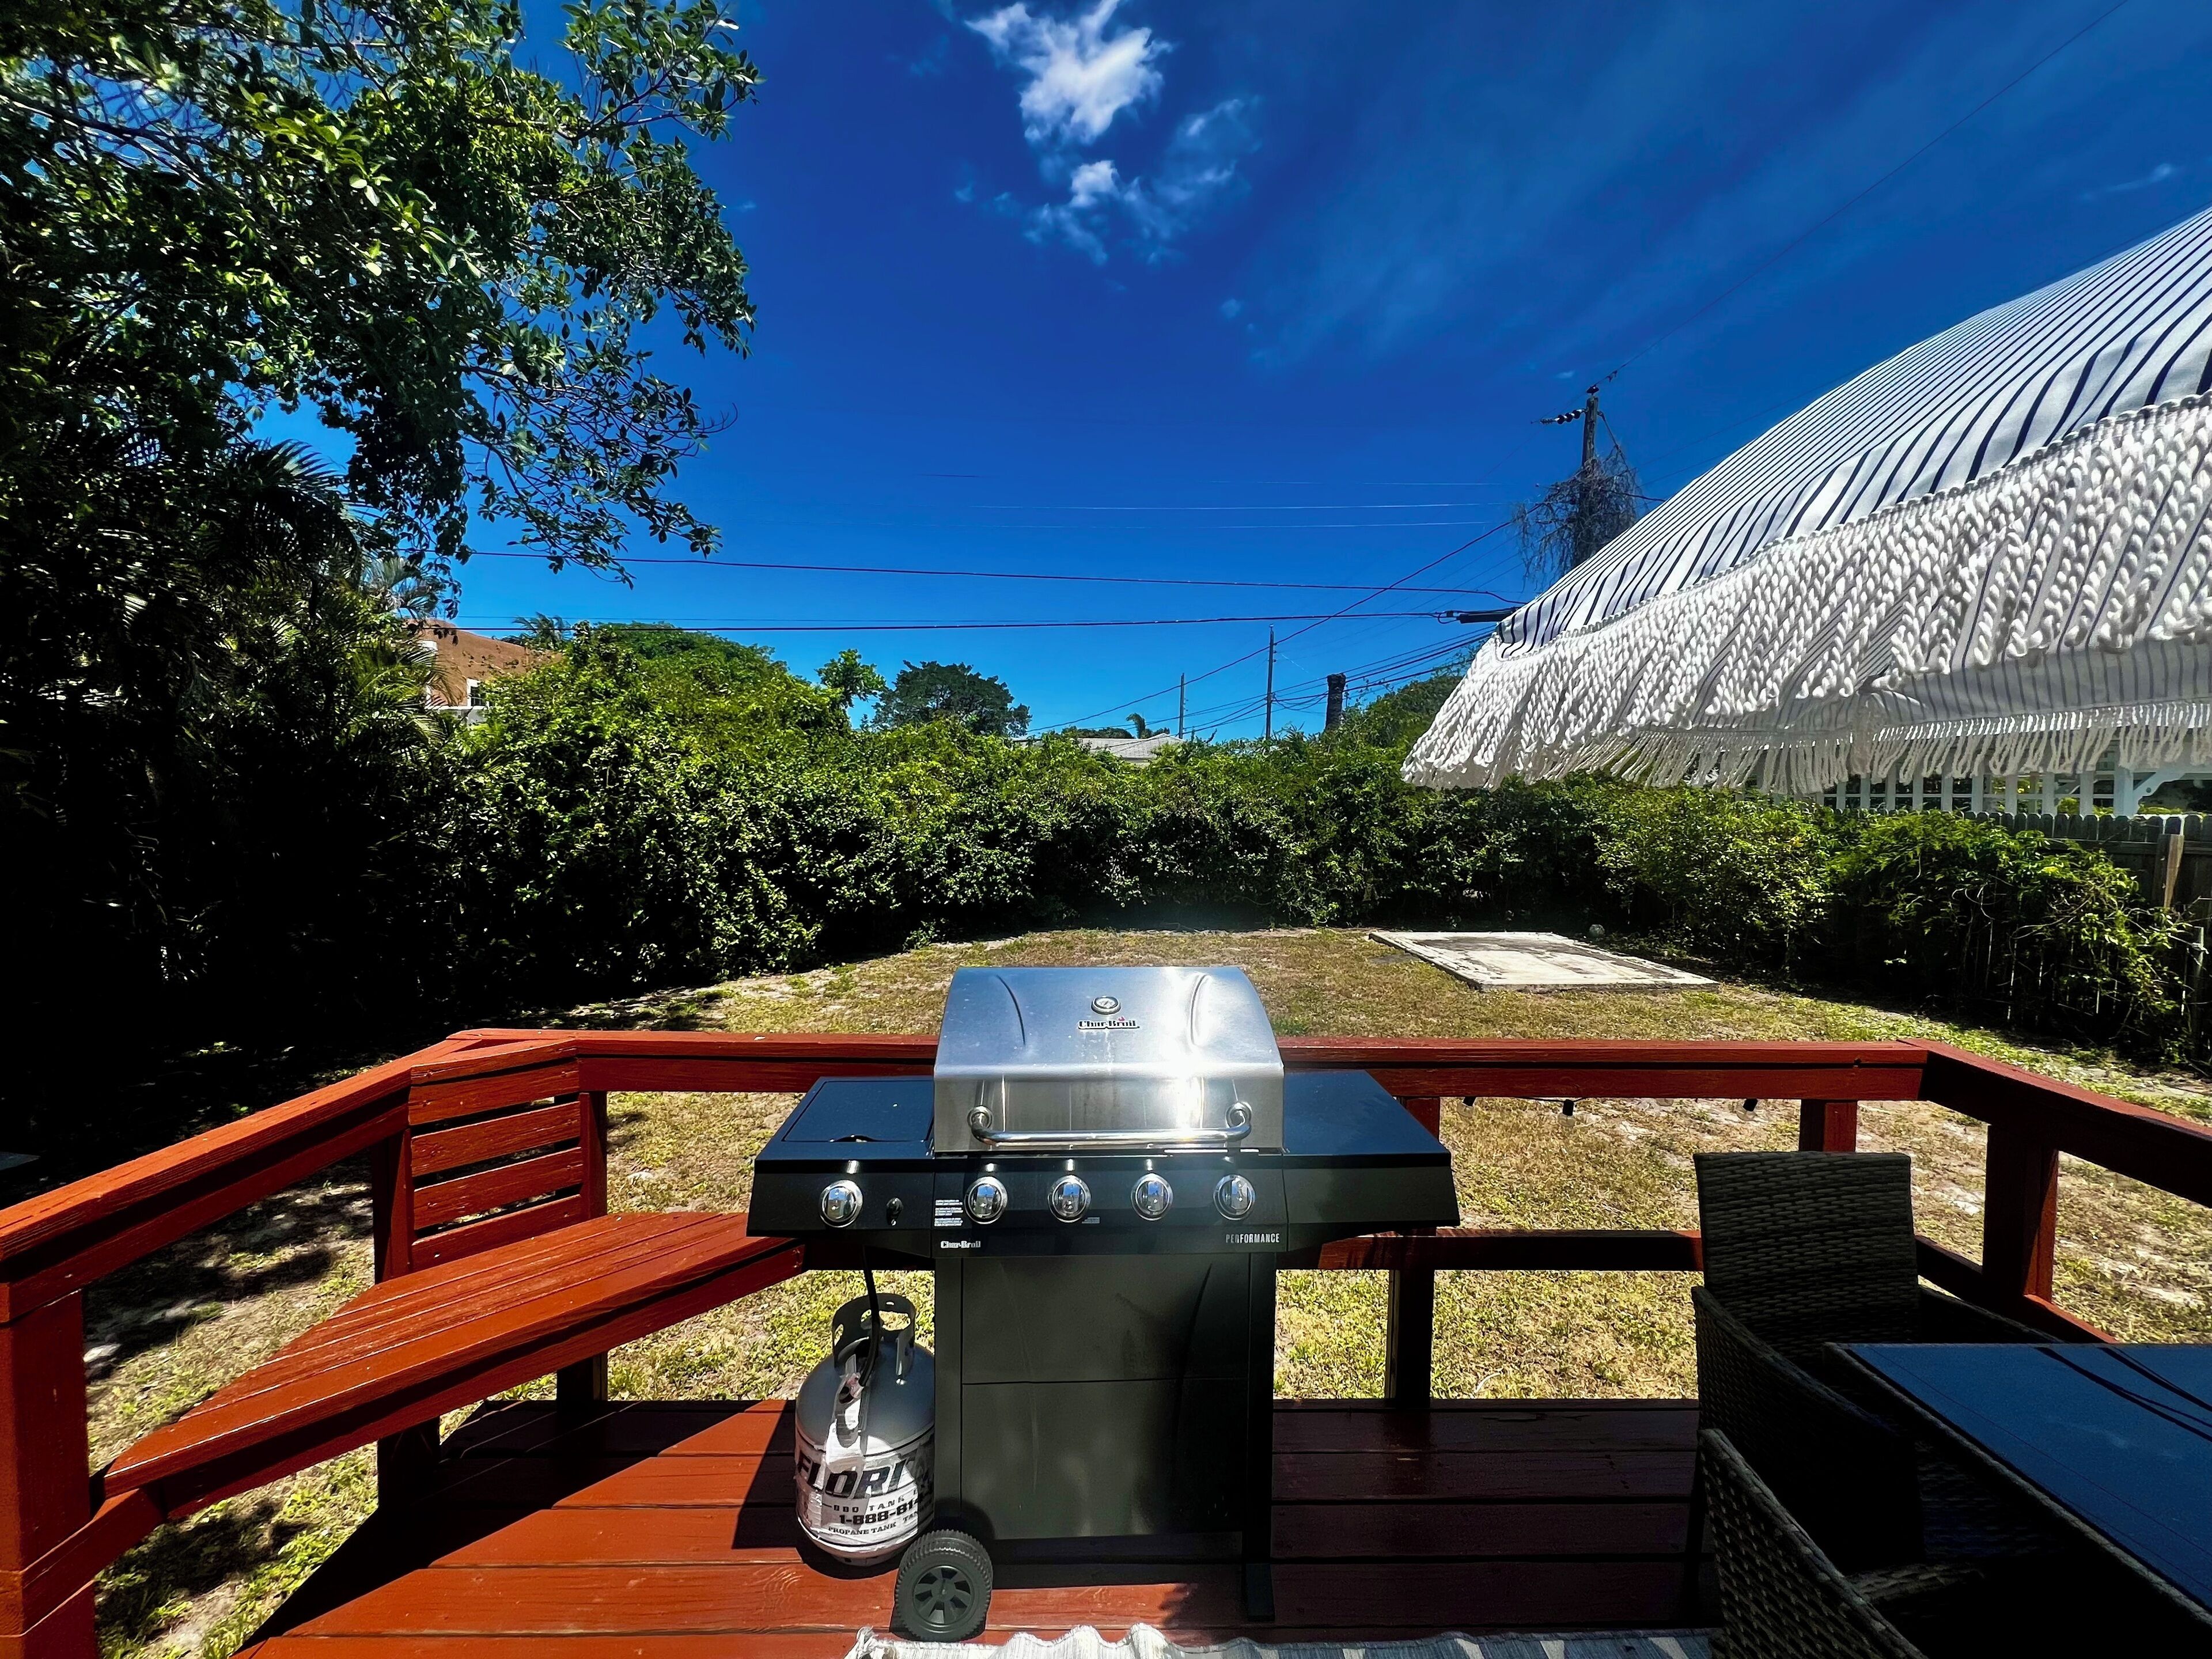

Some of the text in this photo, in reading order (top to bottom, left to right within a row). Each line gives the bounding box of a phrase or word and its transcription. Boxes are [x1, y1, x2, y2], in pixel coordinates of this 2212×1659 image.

[1225, 1233, 1280, 1243] PERFORMANCE
[869, 1497, 904, 1511] TANK
[828, 1527, 869, 1535] PROPANE
[871, 1521, 897, 1535] TANK
